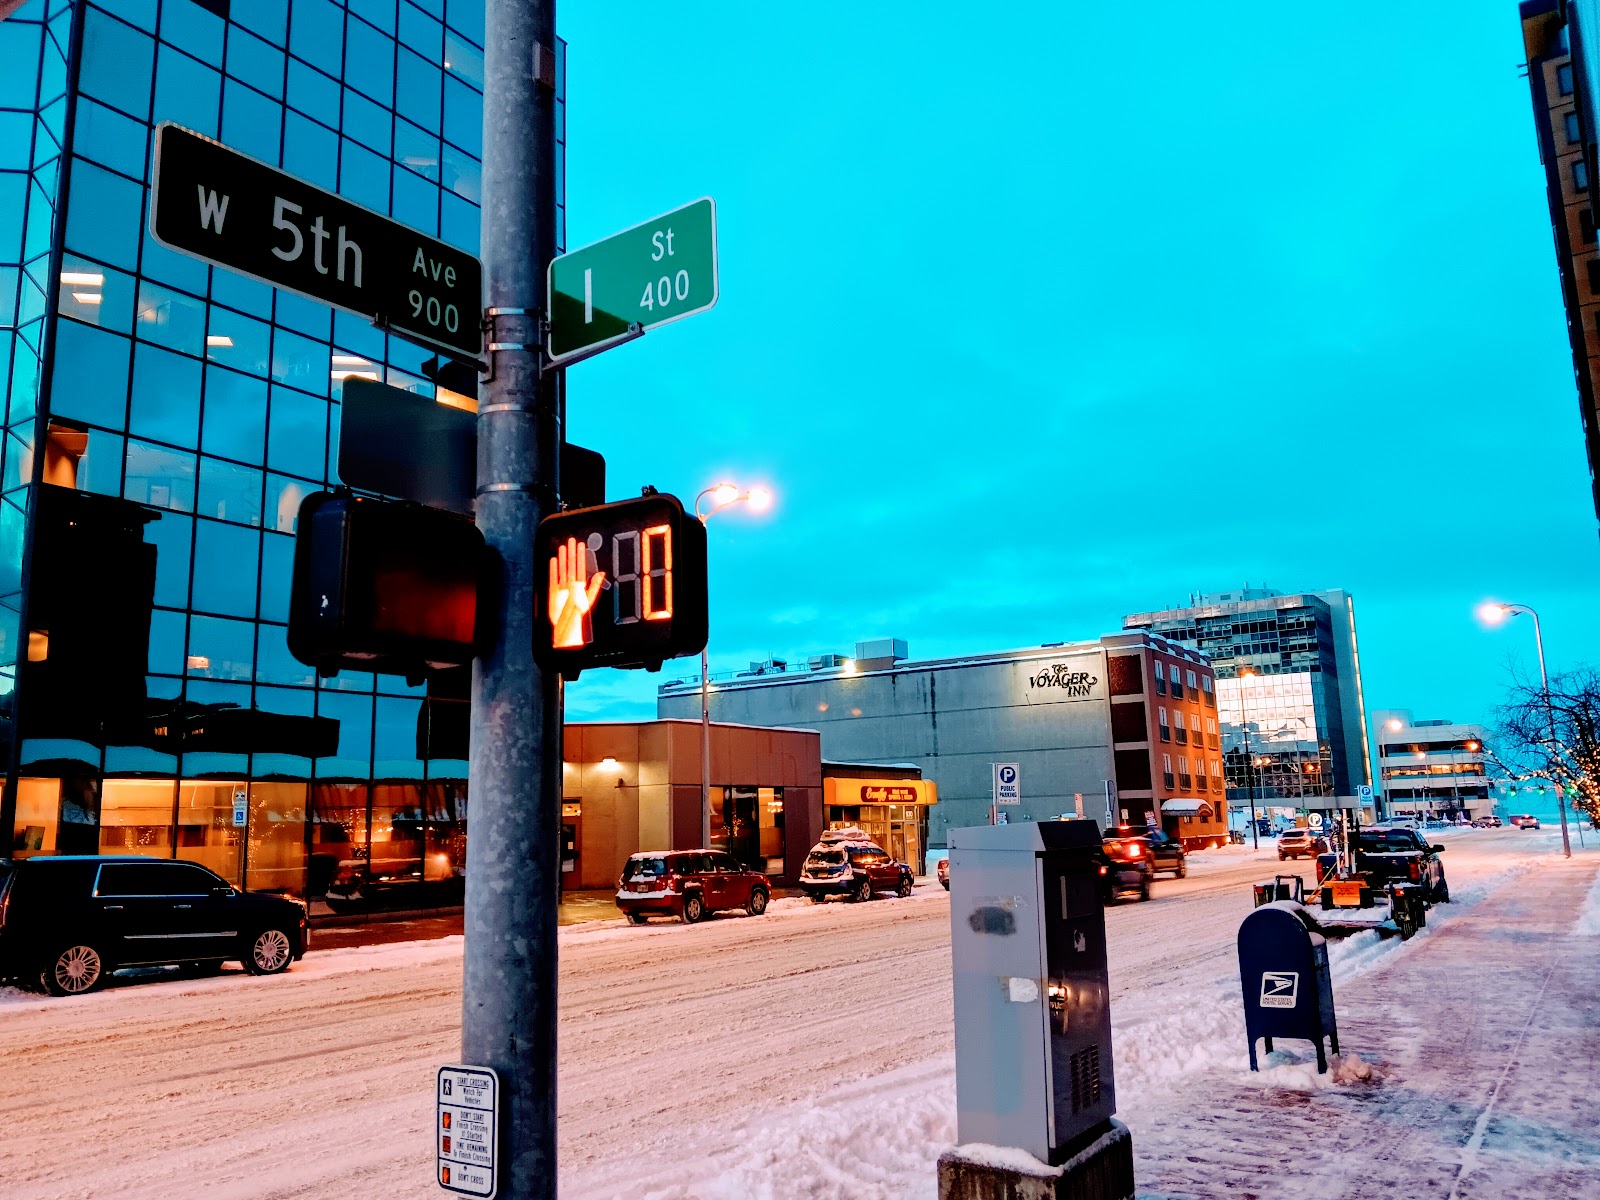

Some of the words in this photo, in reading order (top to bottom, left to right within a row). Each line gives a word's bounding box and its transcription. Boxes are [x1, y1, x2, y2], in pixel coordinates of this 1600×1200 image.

[197, 184, 230, 235] W
[271, 195, 363, 288] 5th
[651, 227, 675, 262] St
[412, 247, 457, 288] Ave
[584, 268, 593, 324] I
[639, 269, 690, 311] 400
[408, 290, 459, 333] 900
[1029, 668, 1098, 689] VOYAGER
[1051, 663, 1069, 675] The
[1068, 684, 1092, 697] INN
[1004, 768, 1014, 782] P
[457, 1077, 468, 1085] START
[470, 1078, 489, 1089] CROSSING
[473, 1113, 484, 1121] START
[471, 1176, 483, 1185] CROSS
